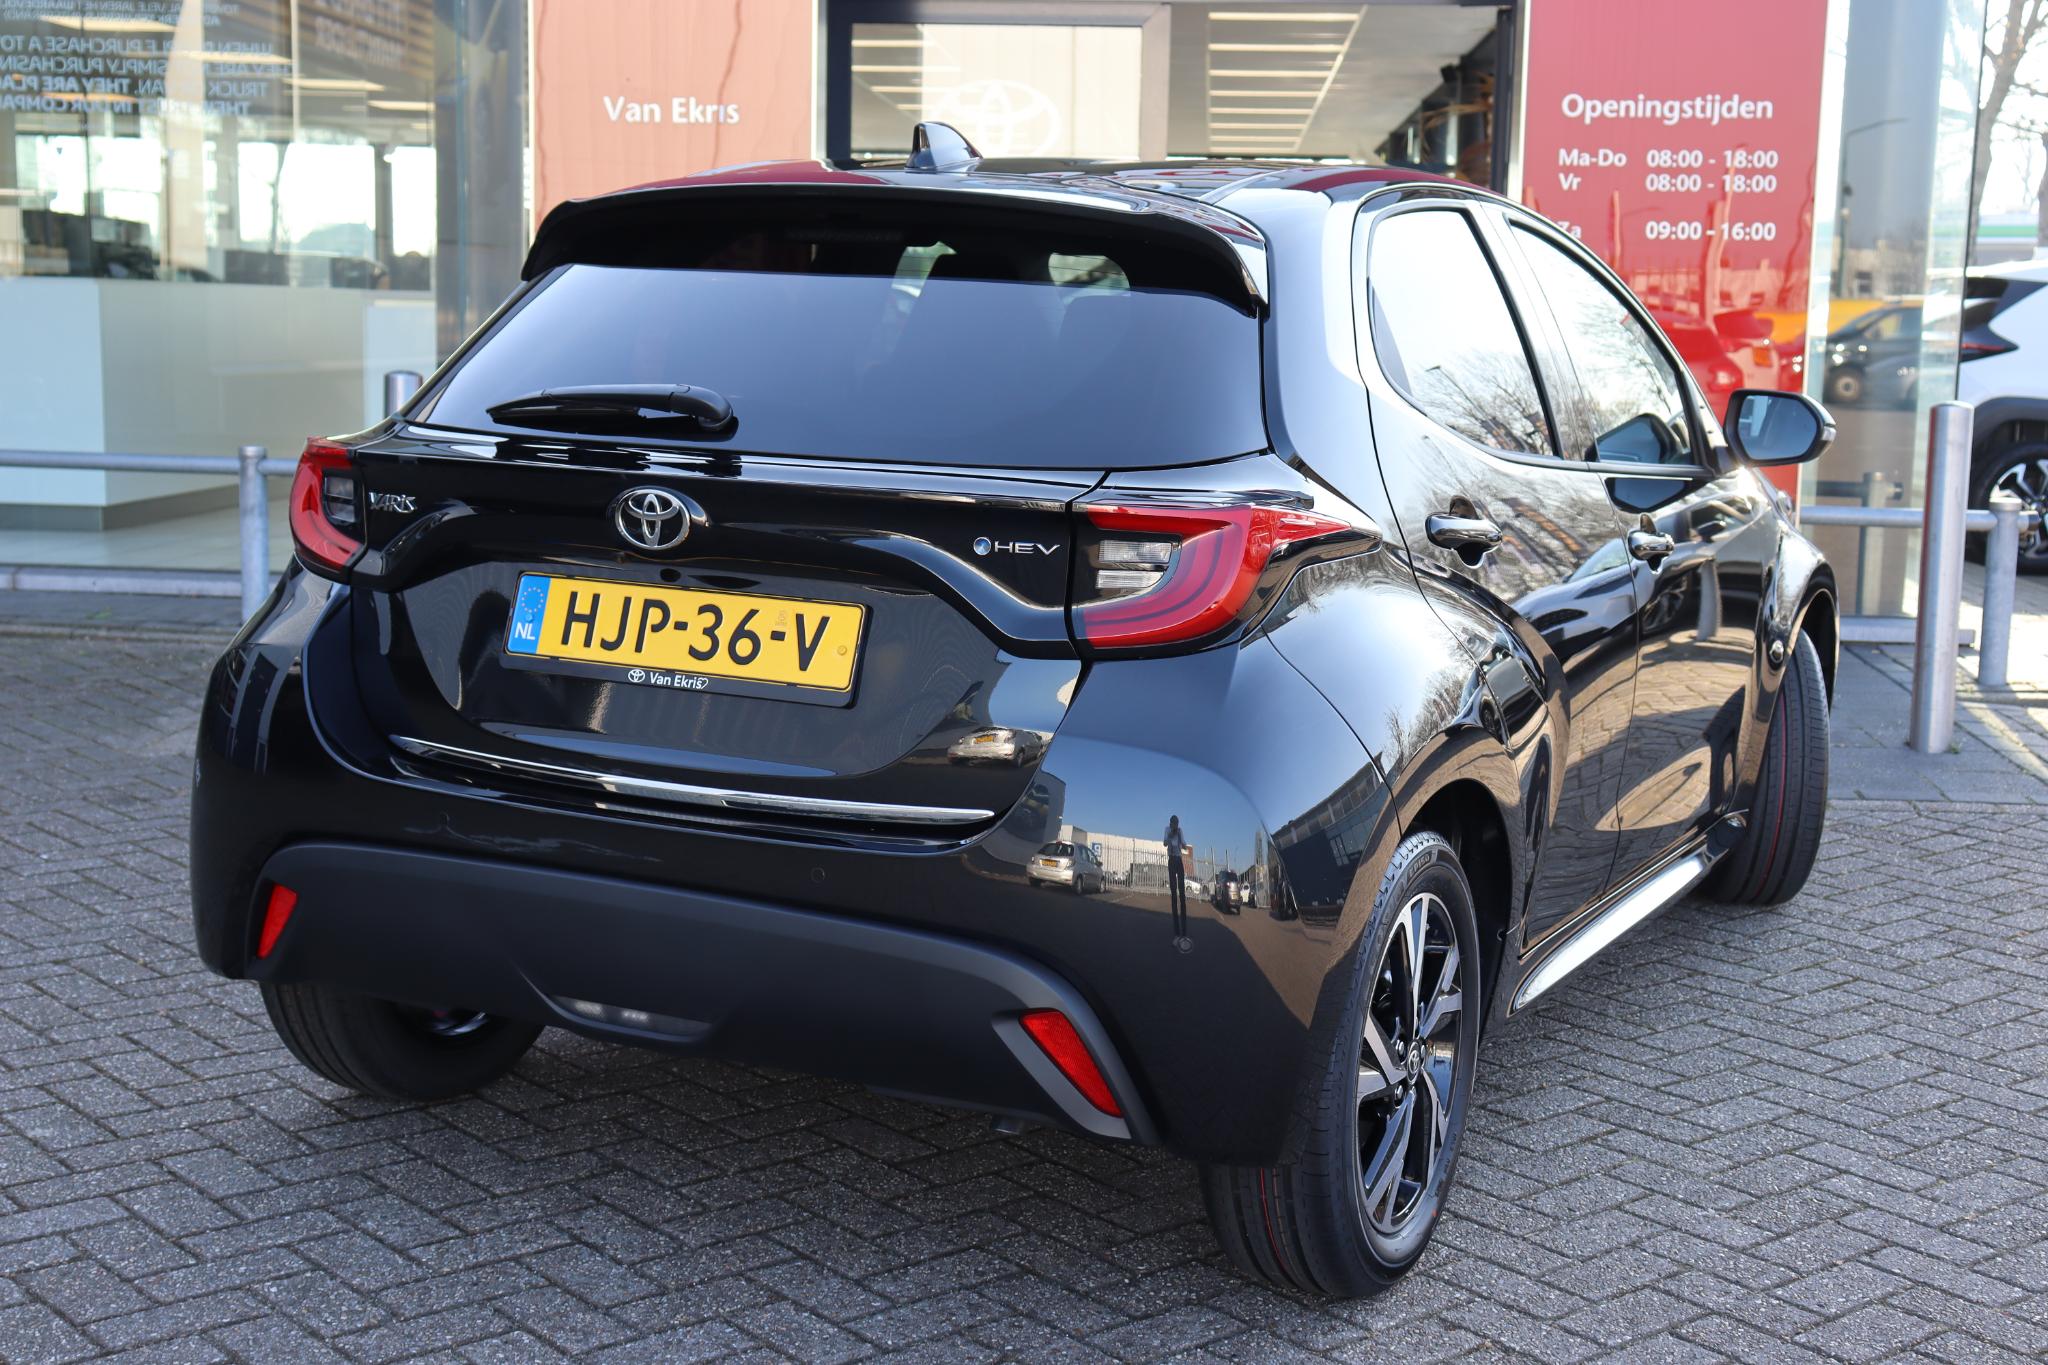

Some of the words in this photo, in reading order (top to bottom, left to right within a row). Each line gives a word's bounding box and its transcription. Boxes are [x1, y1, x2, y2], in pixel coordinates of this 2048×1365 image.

[603, 95, 661, 123] Van
[671, 95, 740, 124] Ekris
[1561, 93, 1774, 125] Openingstijden
[1558, 148, 1628, 167] Ma-Do
[1646, 149, 1703, 168] 08:00
[1723, 150, 1778, 168] 18:00
[1558, 172, 1582, 191] Vr
[1645, 173, 1702, 192] 08:00
[1722, 174, 1777, 192] 18:00
[1645, 221, 1702, 240] 09:00
[1720, 222, 1776, 240] 16:00
[994, 540, 1061, 555] HEV
[514, 622, 536, 641] NL
[560, 591, 831, 672] HJP-36-V
[650, 672, 672, 686] Van
[673, 674, 703, 689] Ekris
